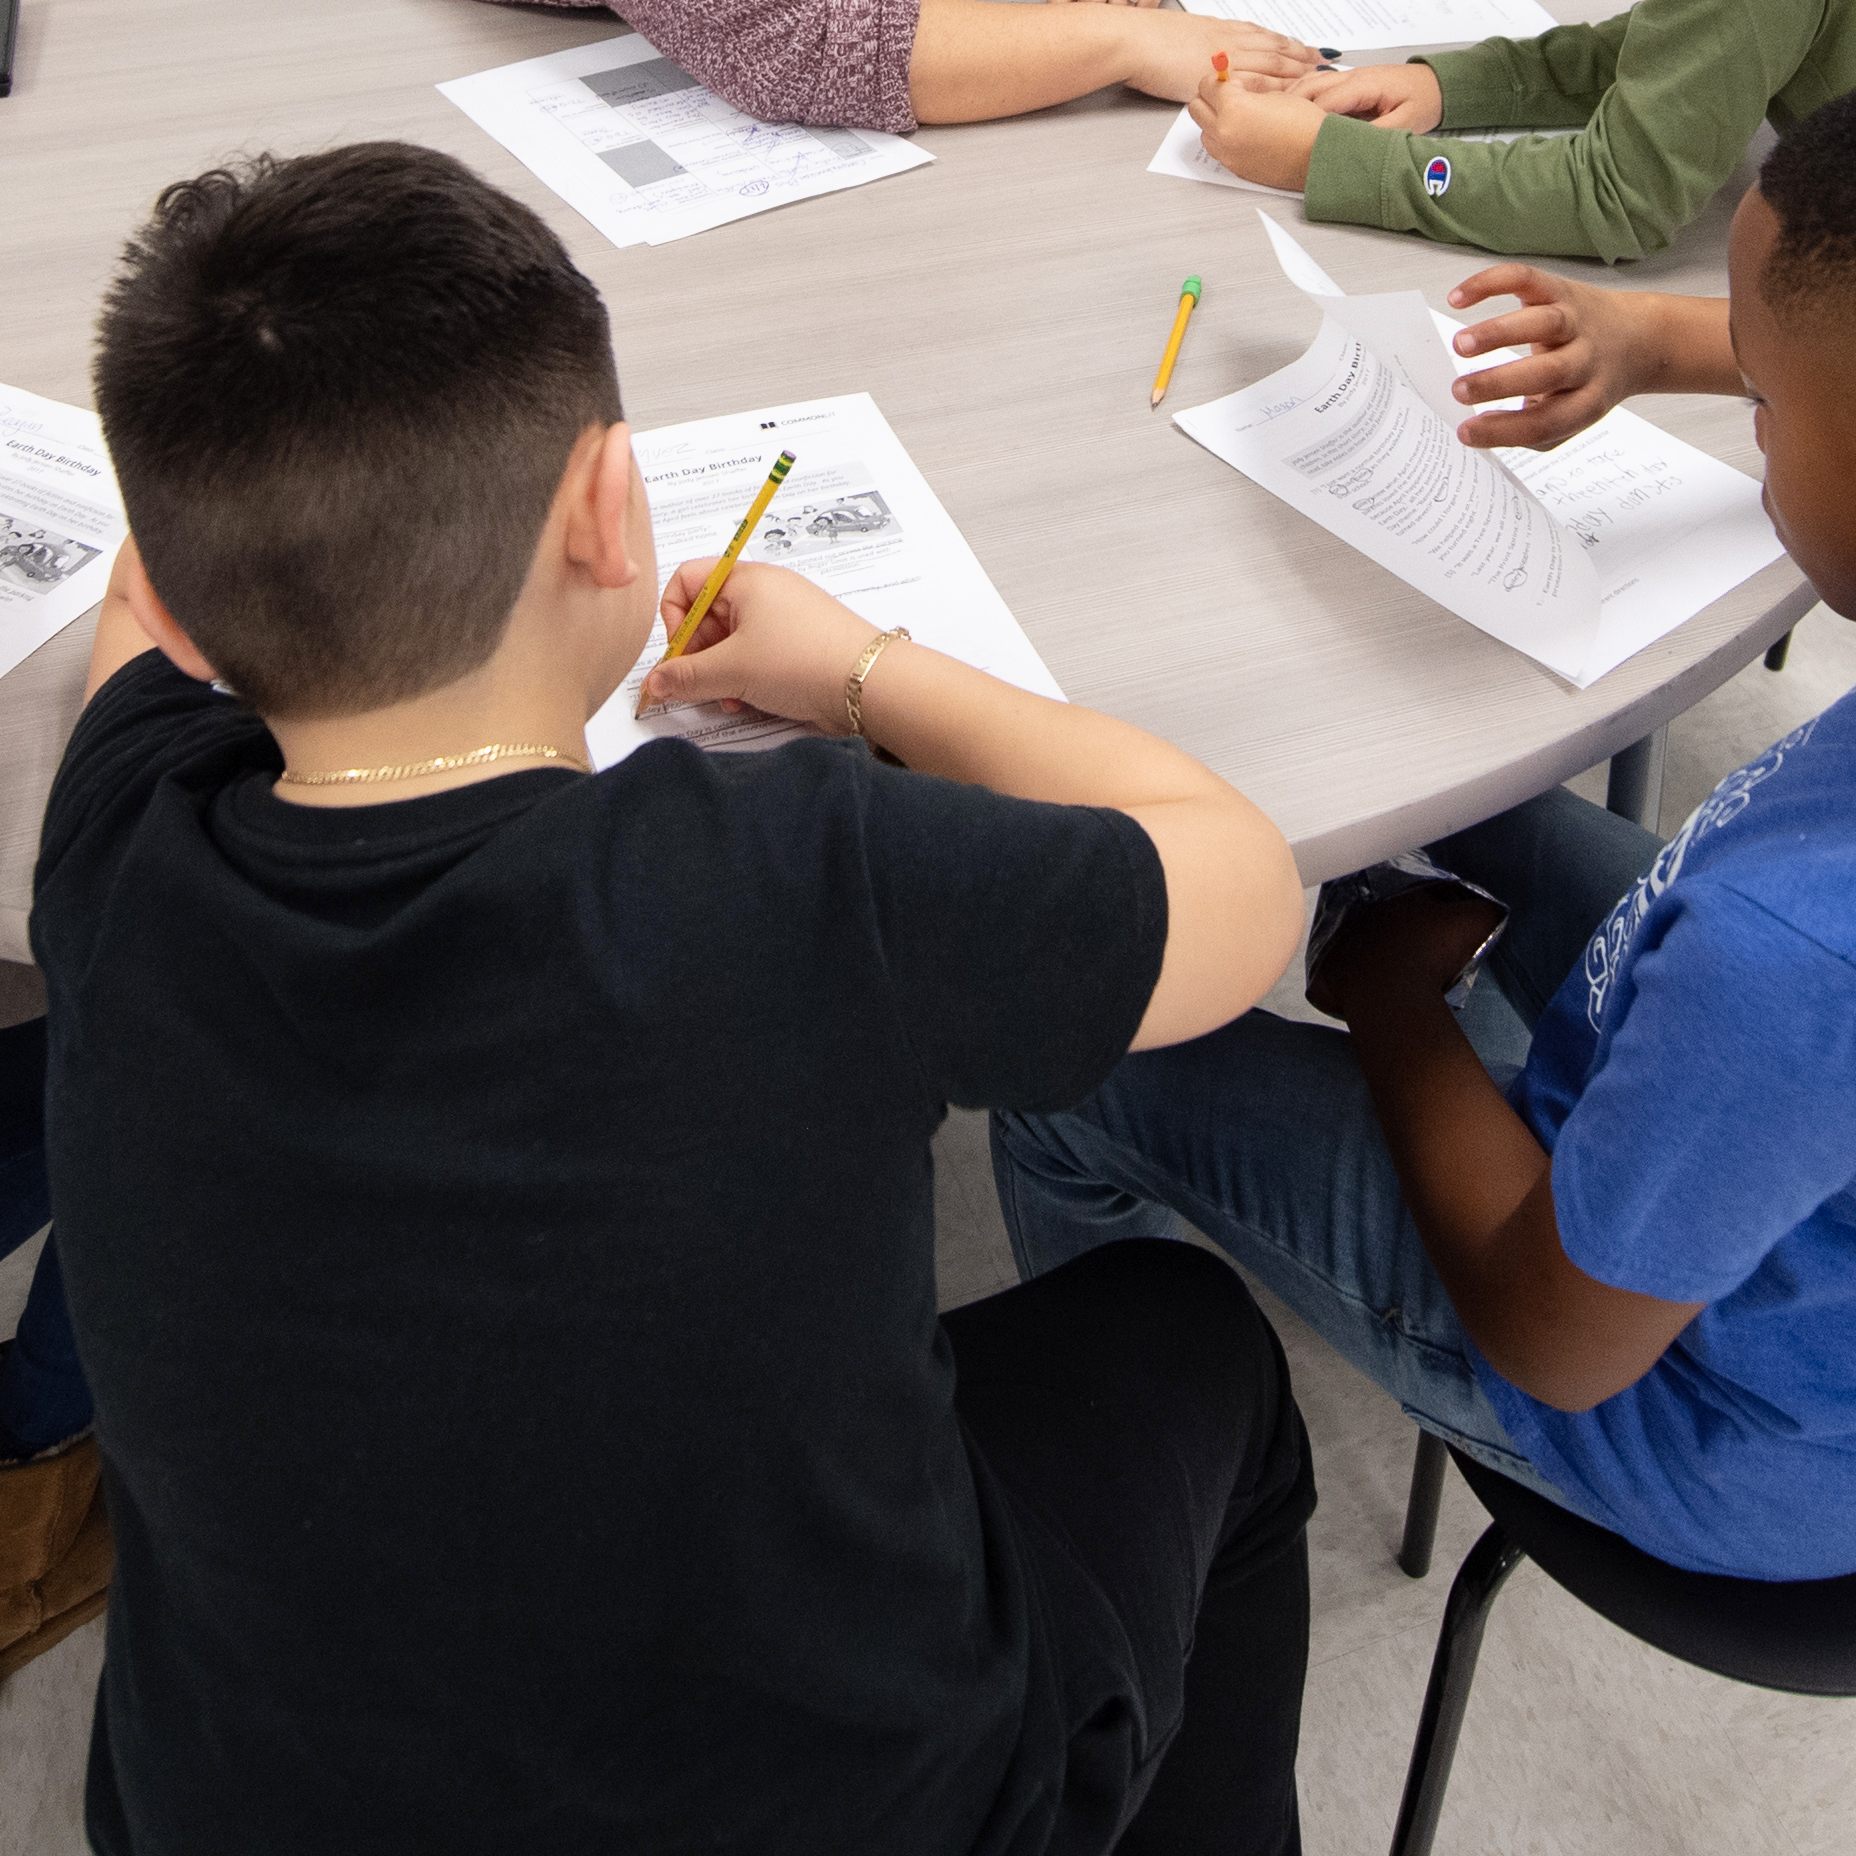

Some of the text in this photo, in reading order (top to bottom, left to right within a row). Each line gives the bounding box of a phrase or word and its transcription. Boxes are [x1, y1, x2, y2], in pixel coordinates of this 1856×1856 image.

[1313, 370, 1357, 416] Earth Day
[6, 438, 102, 478] Earth Day Birthday
[644, 453, 763, 485] Earth Day Birthday
